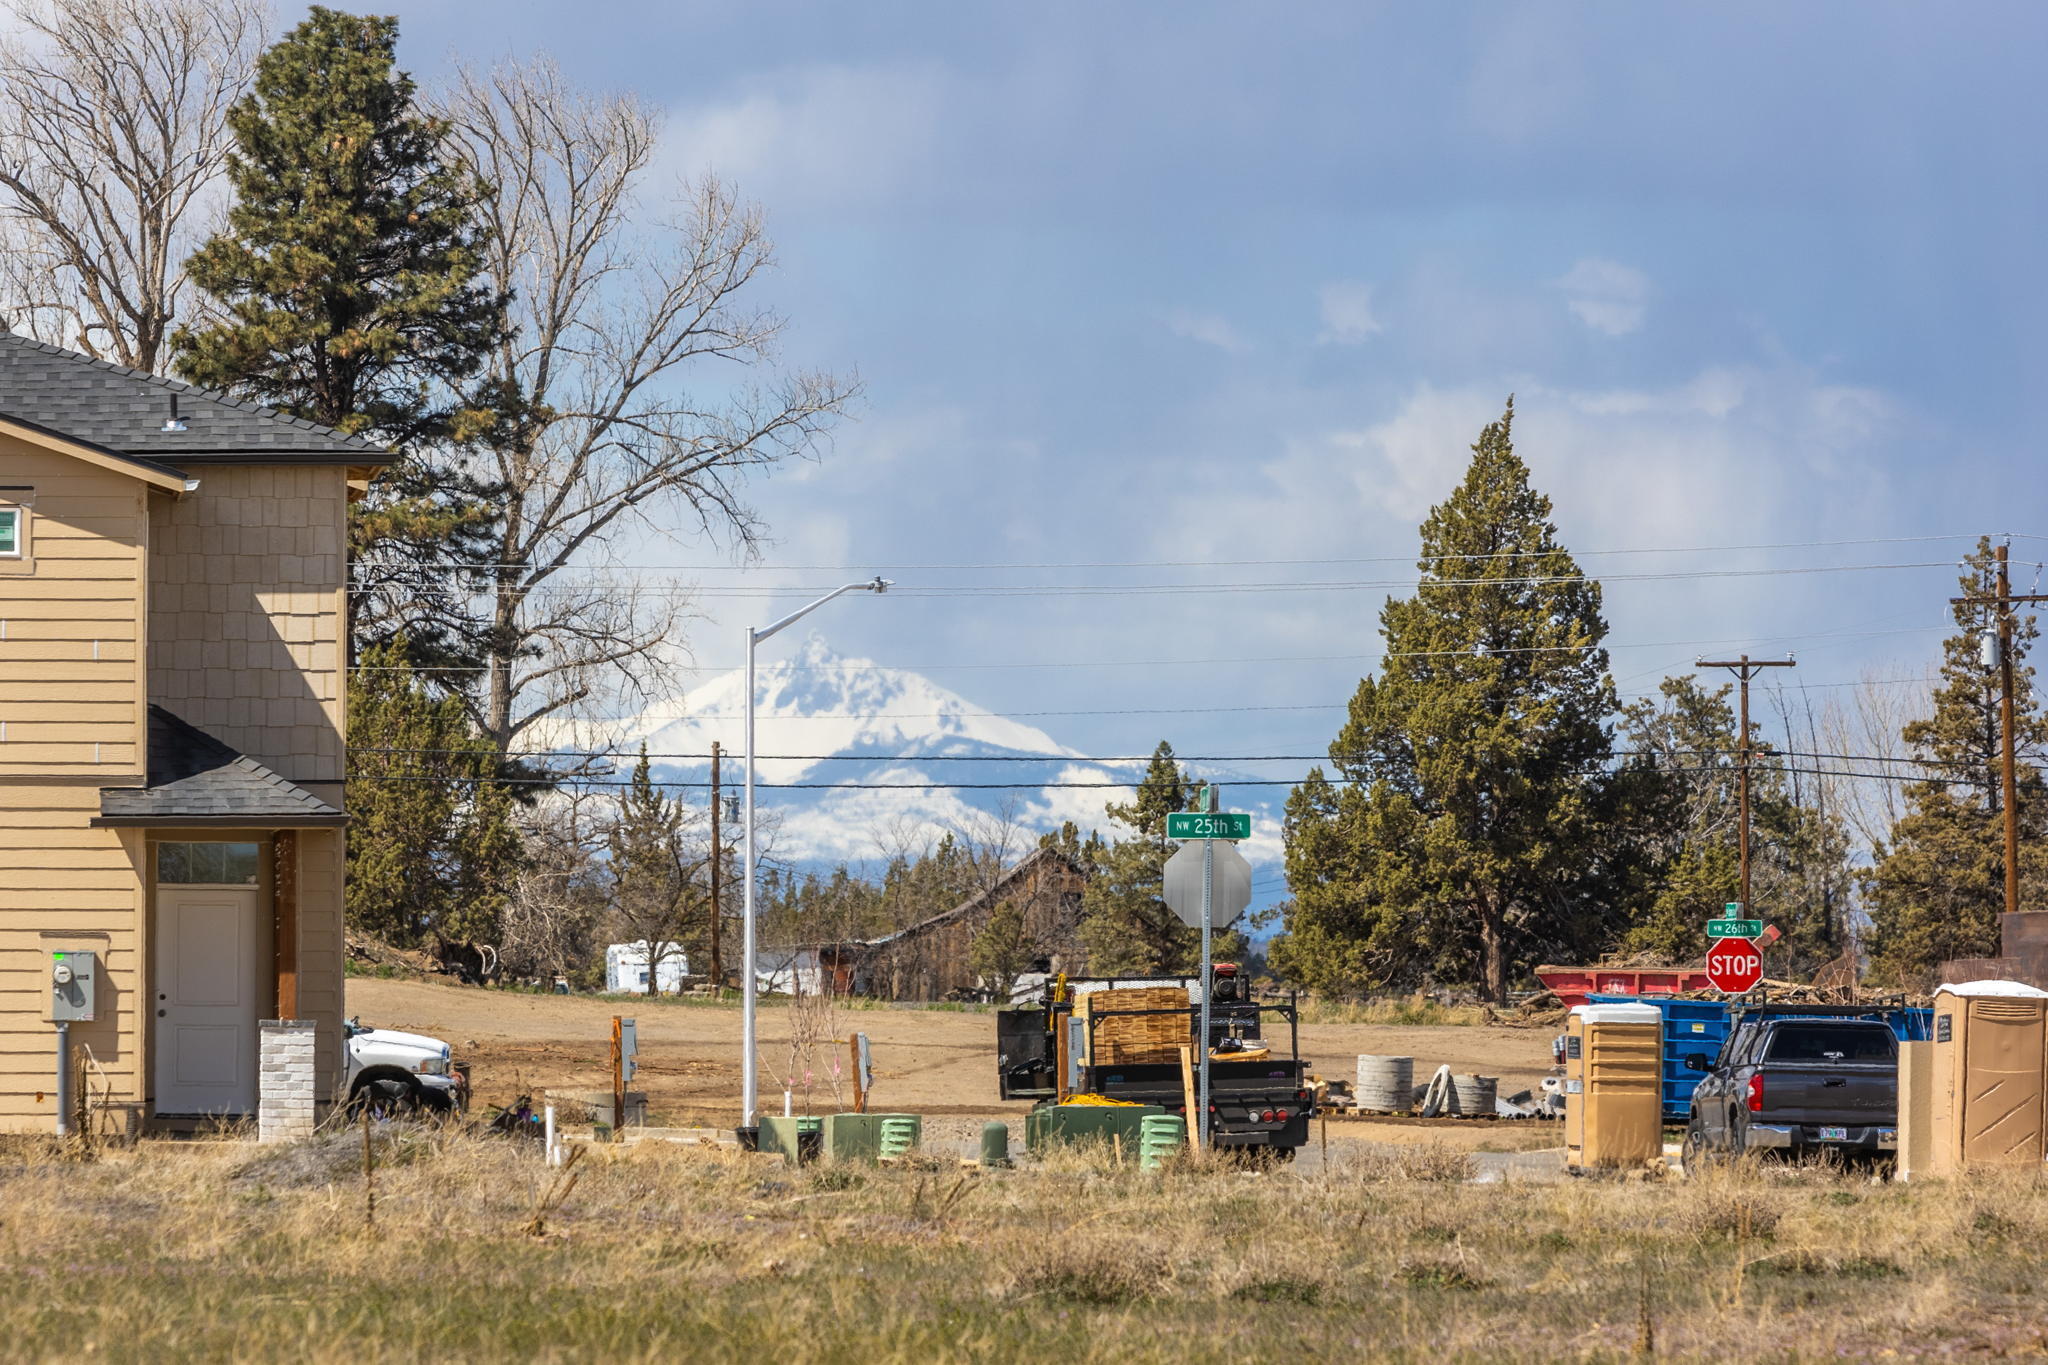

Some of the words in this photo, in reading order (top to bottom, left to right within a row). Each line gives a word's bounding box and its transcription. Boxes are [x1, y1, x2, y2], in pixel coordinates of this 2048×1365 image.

[1176, 821, 1189, 830] NW
[1194, 818, 1228, 834] 25th
[1233, 822, 1243, 831] St
[1724, 923, 1748, 933] 26th
[1711, 955, 1759, 976] STOP
